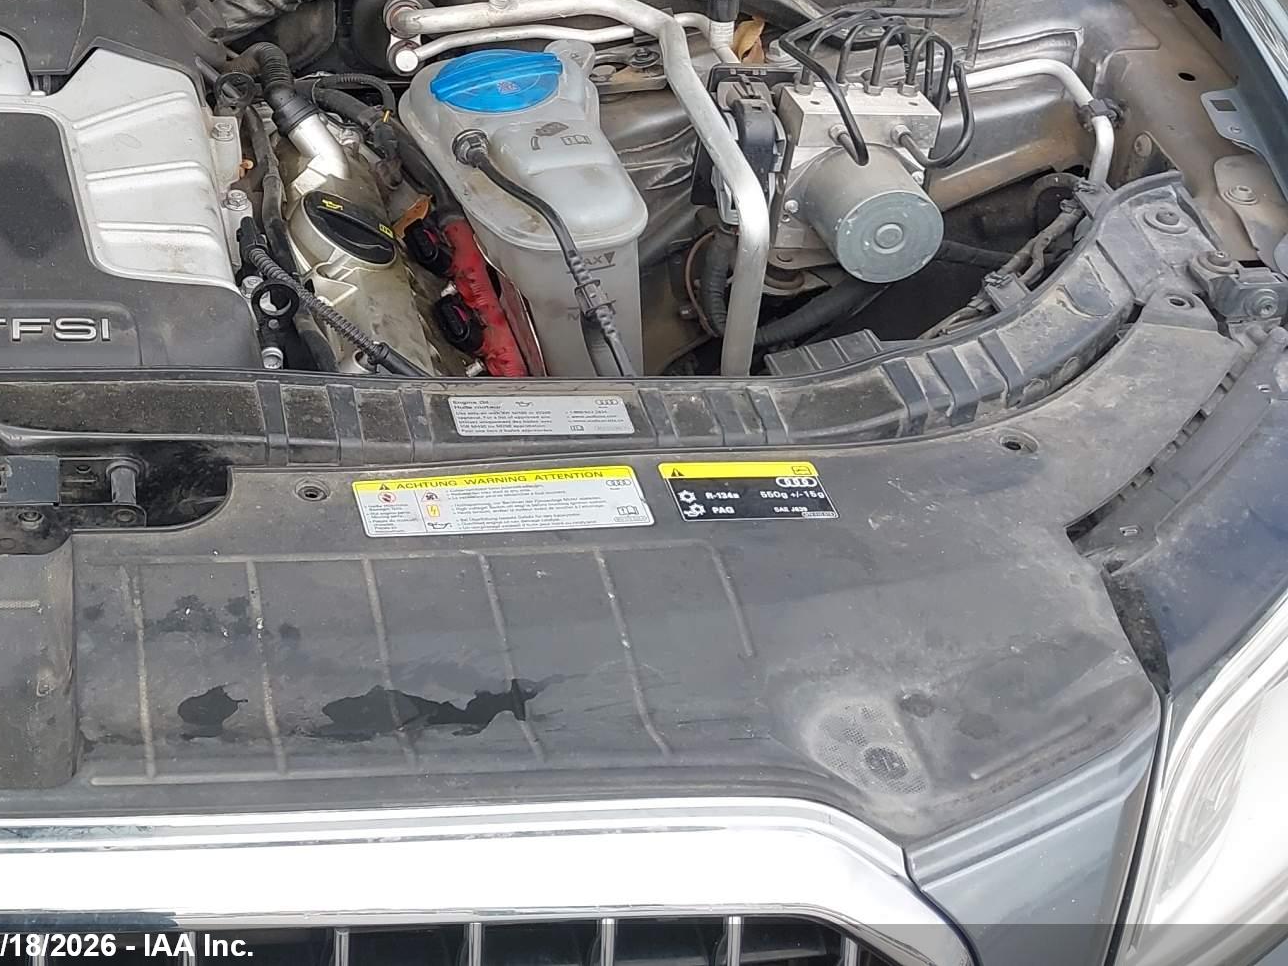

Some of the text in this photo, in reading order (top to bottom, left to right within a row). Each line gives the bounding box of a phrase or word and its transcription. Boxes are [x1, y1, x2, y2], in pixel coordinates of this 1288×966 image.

[396, 471, 604, 490] ACHTUNG WARNING ATTENTION
[705, 491, 740, 500] R-134a
[760, 490, 789, 500] 550g
[711, 506, 735, 514] PAG
